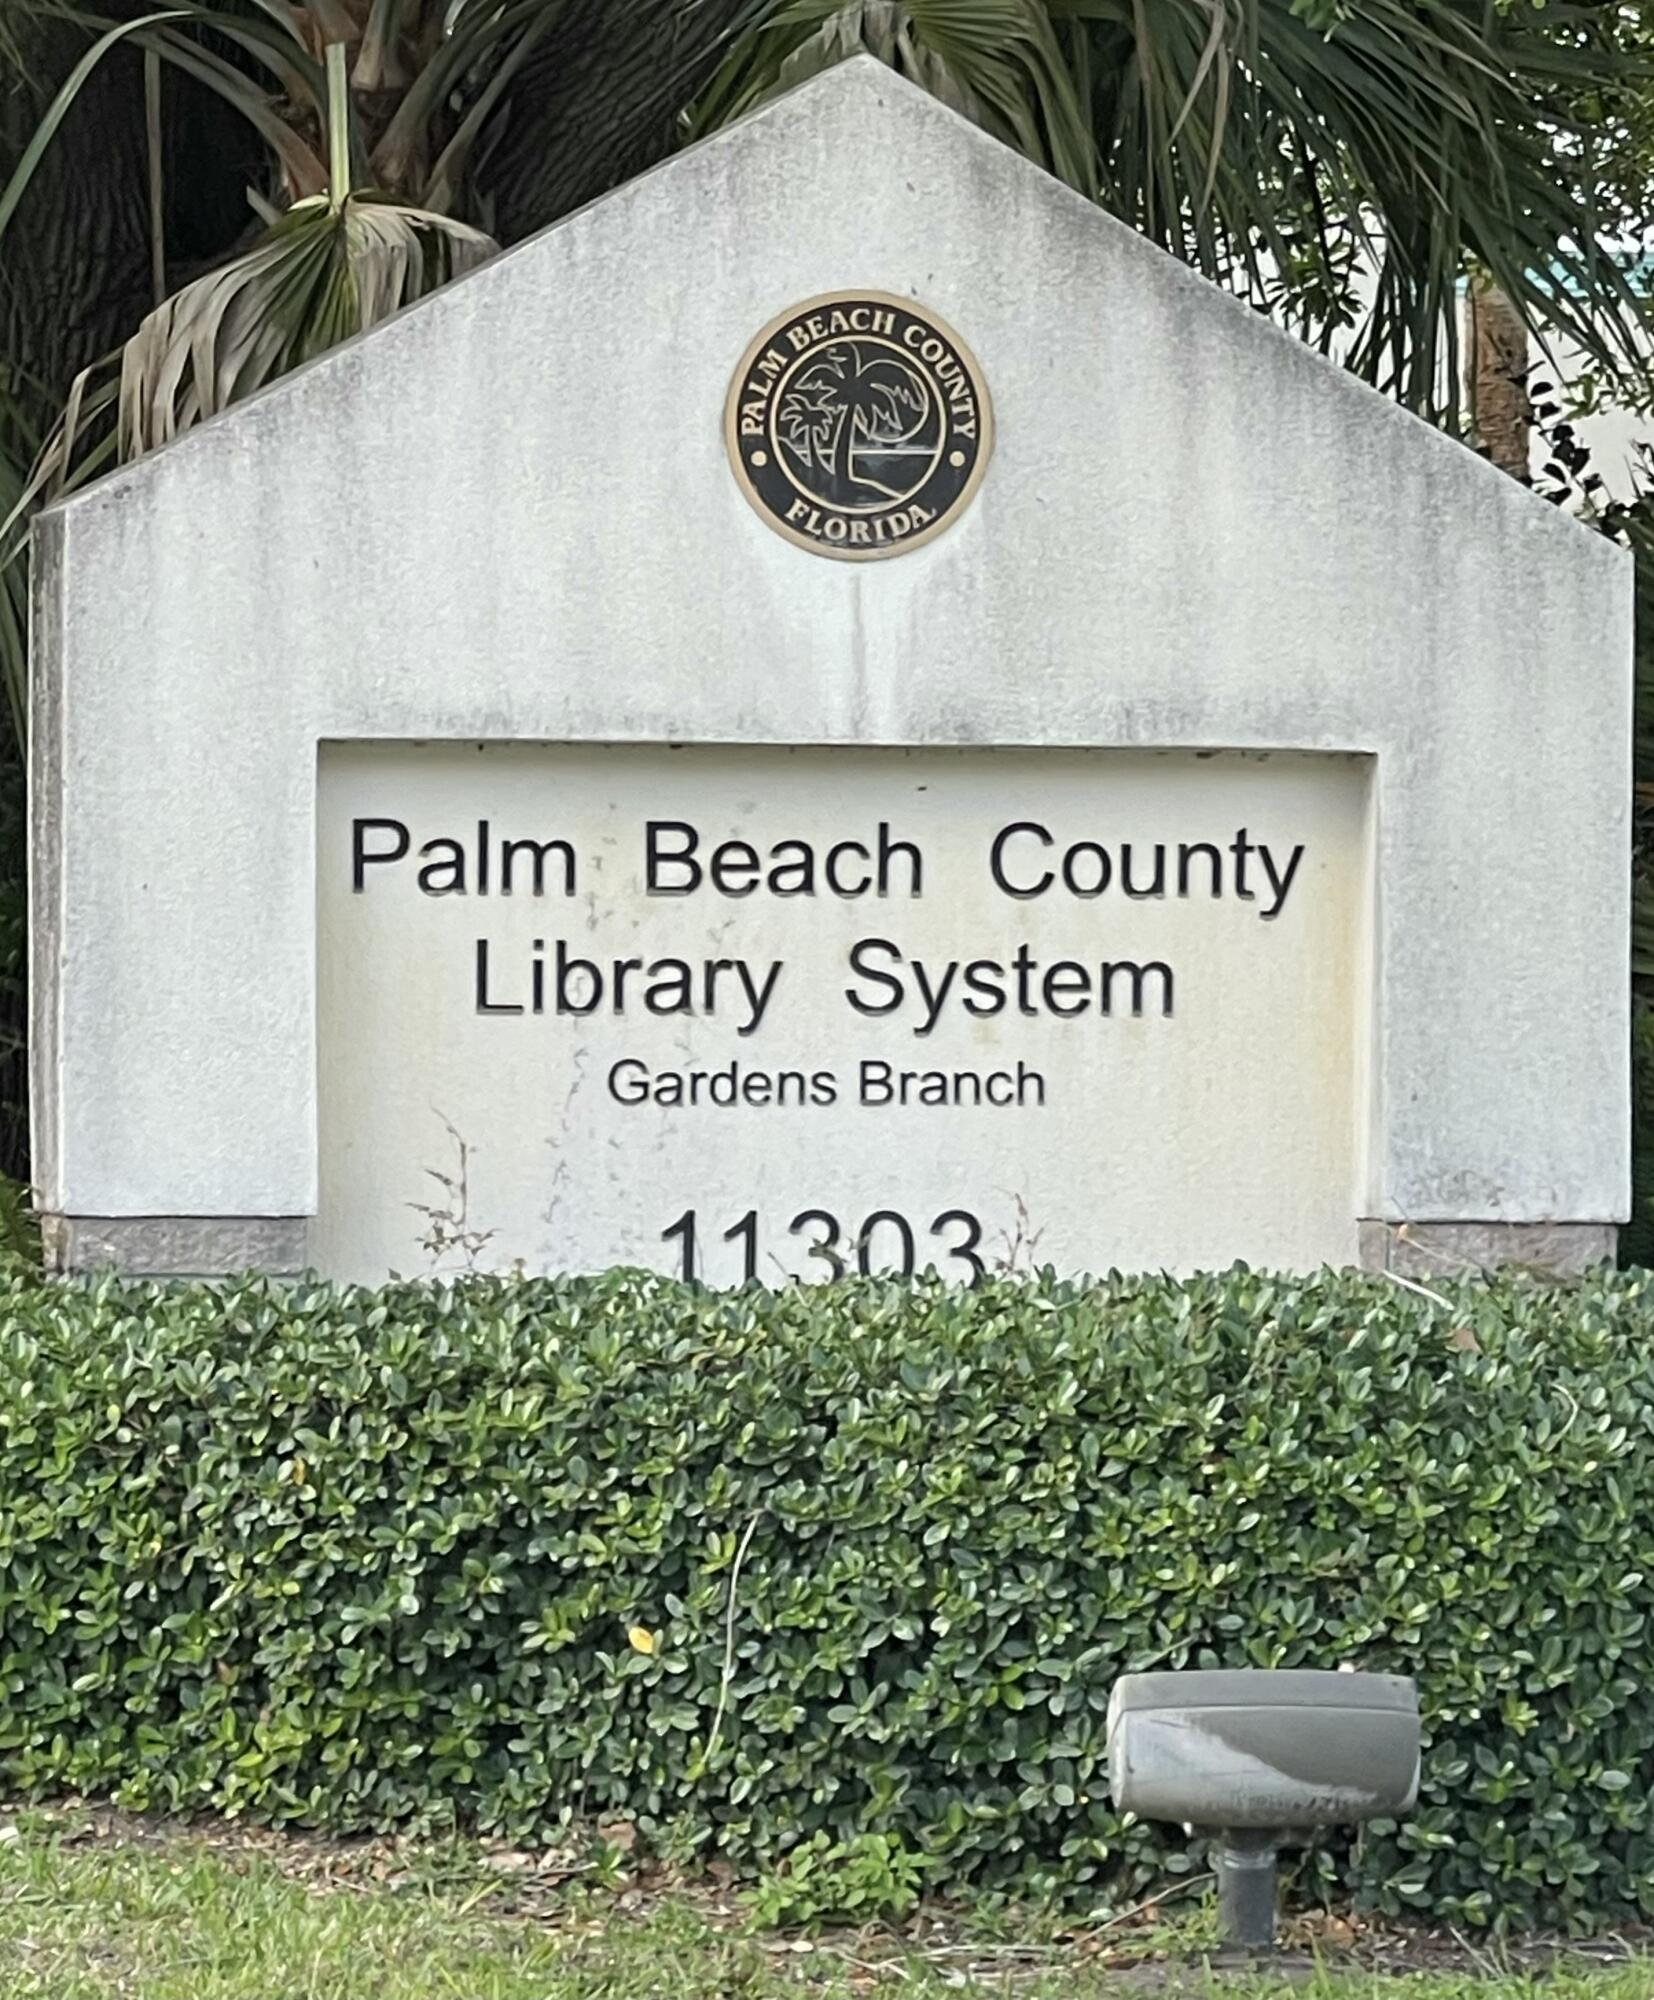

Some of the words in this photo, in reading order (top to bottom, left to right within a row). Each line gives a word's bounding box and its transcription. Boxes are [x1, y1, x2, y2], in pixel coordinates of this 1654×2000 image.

[741, 349, 788, 436] PALM
[785, 308, 896, 351] BEACH
[903, 324, 976, 439] COUNTY
[785, 498, 936, 543] FLORIDA
[352, 818, 575, 896] Palm
[646, 820, 922, 896] Beach
[990, 821, 1305, 917] County
[477, 939, 783, 1035] Library
[845, 938, 1173, 1034] System
[608, 1058, 837, 1106] Gardens
[860, 1060, 1044, 1105] Branch
[661, 1208, 985, 1290] 11303
